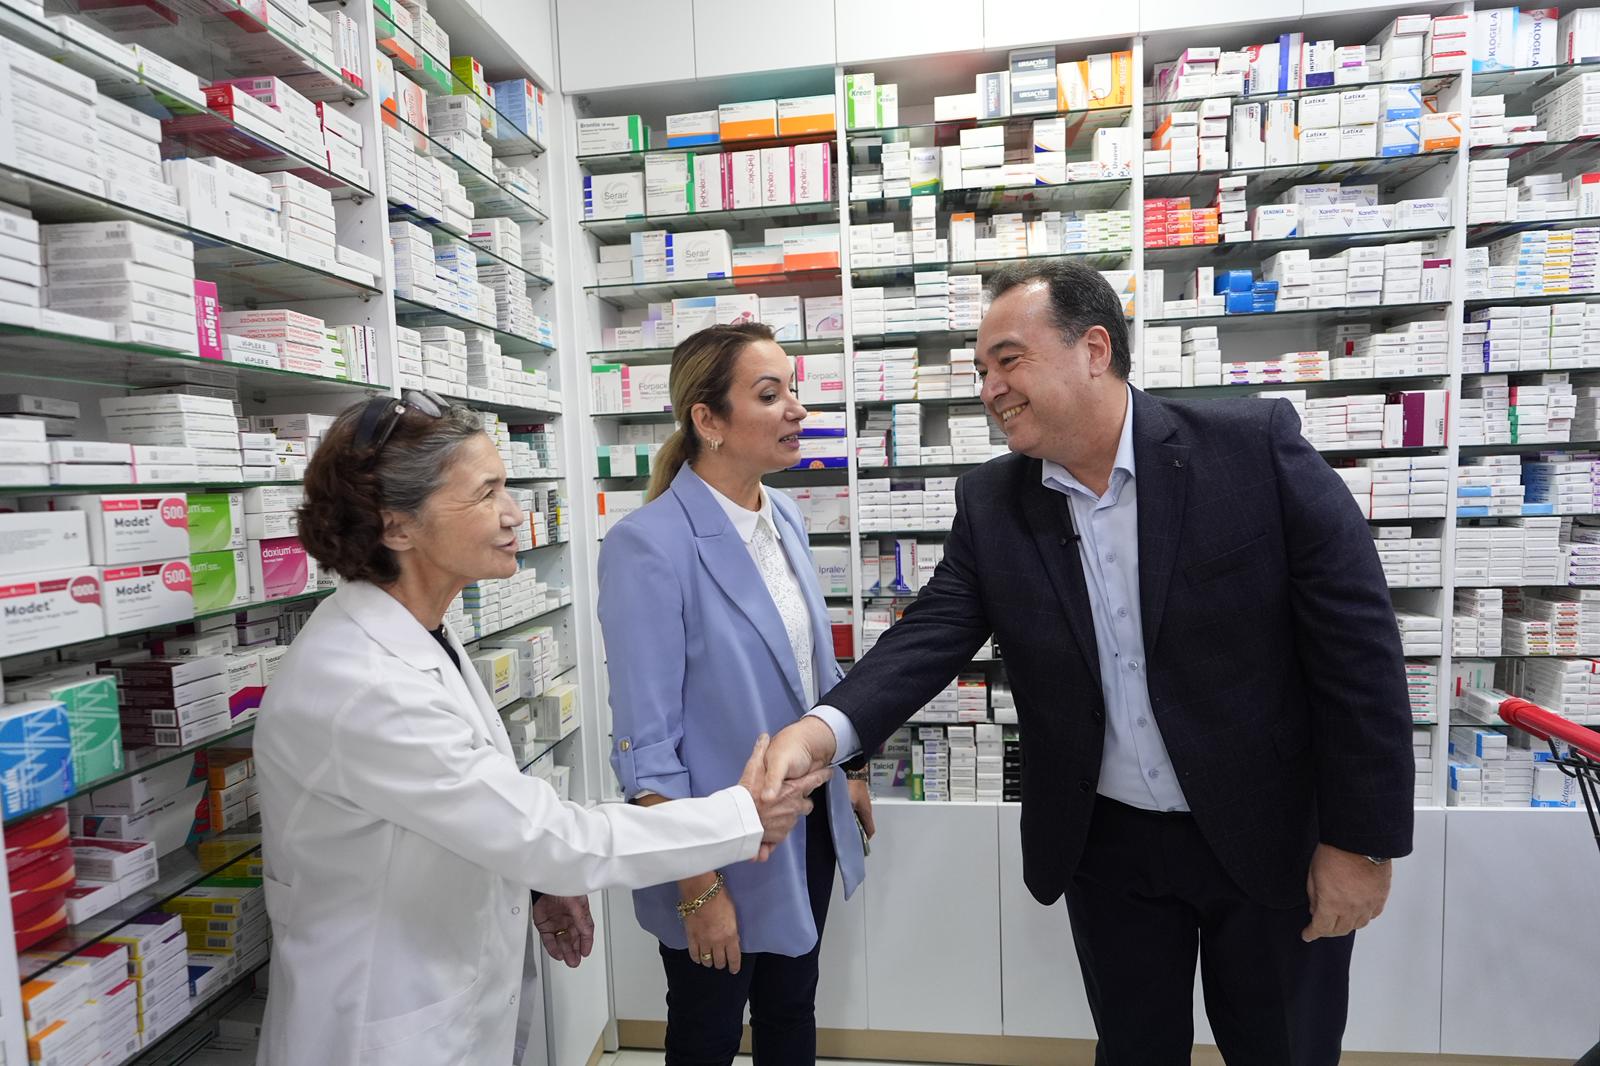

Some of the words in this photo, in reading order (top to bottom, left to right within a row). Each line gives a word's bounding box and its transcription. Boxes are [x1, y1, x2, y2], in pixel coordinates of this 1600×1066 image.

[1489, 12, 1498, 56] KLOGEL-A
[1532, 22, 1542, 66] KLOGEL-A
[204, 296, 217, 347] Evigen
[638, 382, 668, 391] Forpack
[163, 506, 183, 519] 500
[114, 517, 151, 528] Modet
[262, 547, 291, 558] doxium
[818, 565, 846, 575] Ipralev
[165, 570, 185, 584] 500
[116, 585, 152, 596] Modet
[4, 602, 49, 616] Modet
[872, 762, 894, 770] Talcid
